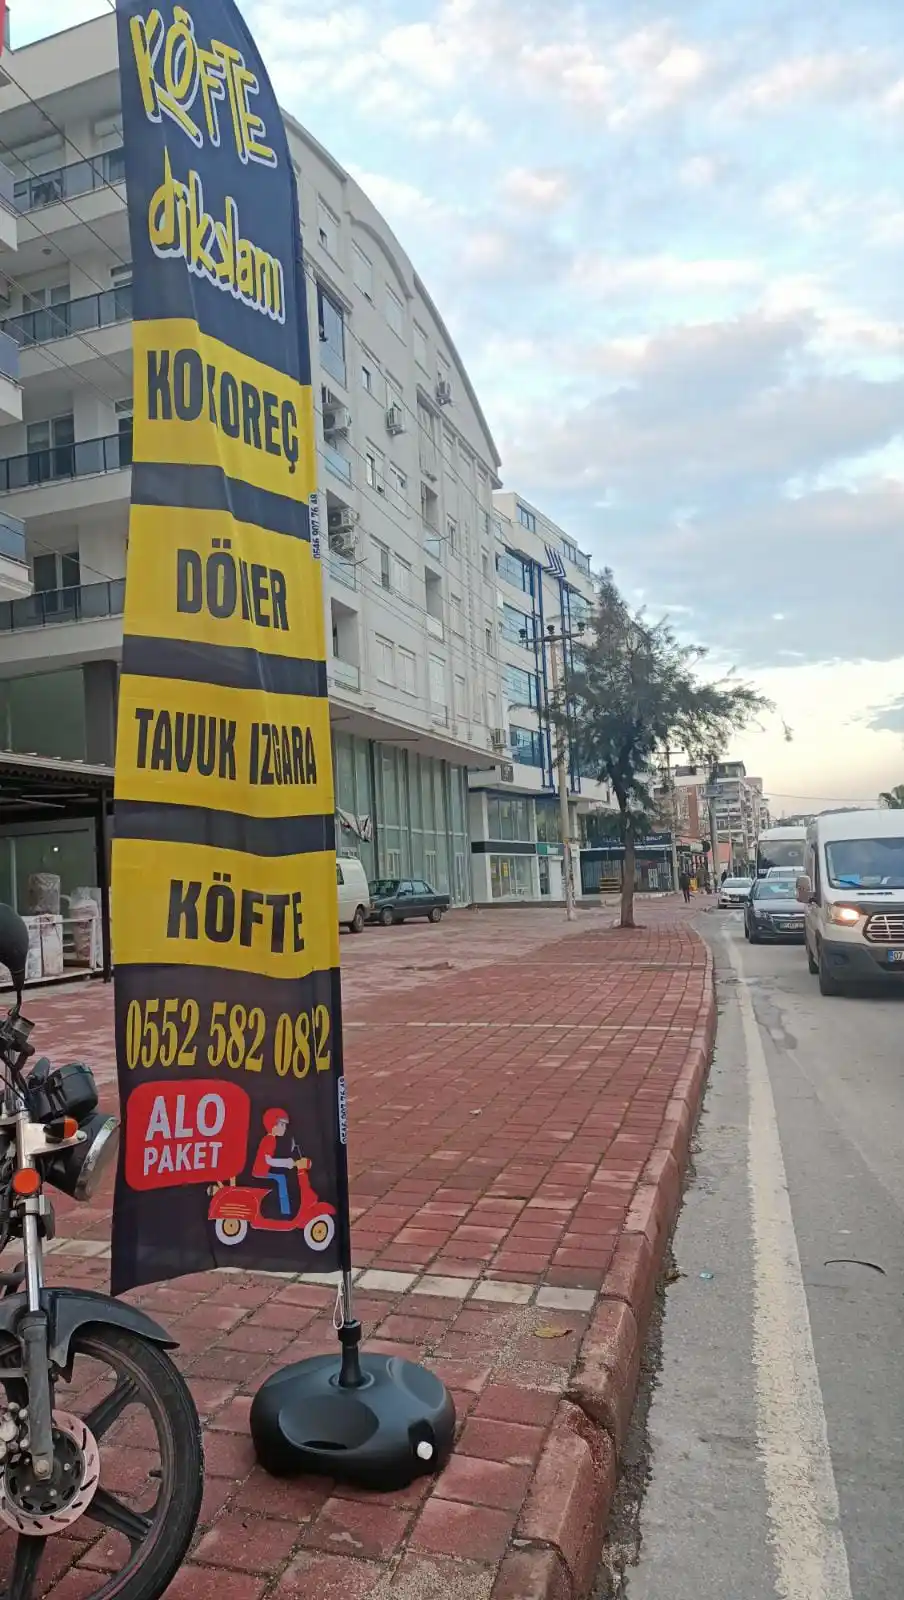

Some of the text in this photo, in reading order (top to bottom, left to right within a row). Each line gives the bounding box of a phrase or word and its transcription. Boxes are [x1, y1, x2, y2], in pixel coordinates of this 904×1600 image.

[130, 6, 278, 168] KÖFTE
[147, 348, 299, 474] KOKOREÇ
[135, 707, 317, 785] TAVUK IZGARA
[166, 872, 305, 953] KÖFTE
[126, 998, 200, 1069] 0552
[207, 1002, 267, 1072] 582
[145, 1093, 226, 1141] ALO
[143, 1141, 223, 1176] PAKET
